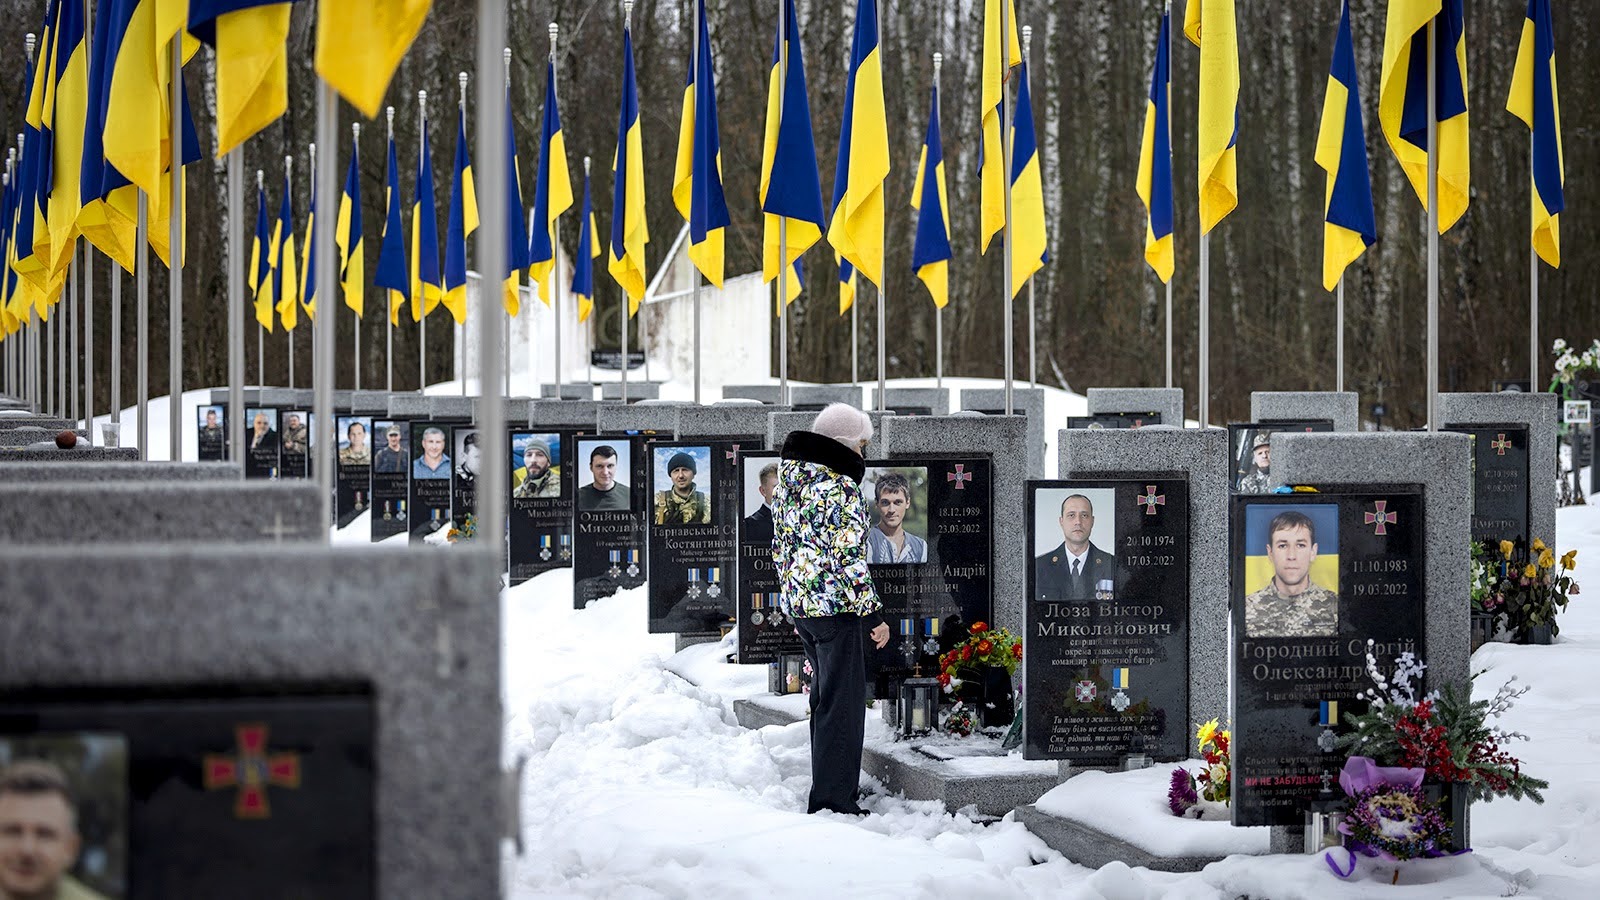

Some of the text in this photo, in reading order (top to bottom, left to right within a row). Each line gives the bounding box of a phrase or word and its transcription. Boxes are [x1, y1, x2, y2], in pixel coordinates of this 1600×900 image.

[718, 479, 737, 487] 19.10
[551, 498, 572, 508] Рост
[527, 508, 573, 518] Михайлов
[580, 511, 637, 522] Олійник
[939, 507, 981, 517] 18.12.1989
[579, 522, 646, 533] Миколайо
[652, 524, 736, 539] Тарнавський Се
[938, 523, 981, 533] 23.03.2022
[665, 538, 736, 550] Костянтинов
[1126, 535, 1175, 547] 20.10.1974
[742, 544, 773, 557] Піпк
[1127, 555, 1175, 566] 17.03.2022
[1353, 559, 1408, 572] 11.10.1983
[872, 563, 986, 580] асковський Андрій
[1353, 583, 1408, 596] 19.03.2022
[1045, 601, 1164, 620] Лоза Віктор
[1037, 621, 1172, 637] Миколайович
[1242, 640, 1340, 663] Городний
[1244, 777, 1258, 787] МИ
[1260, 776, 1272, 786] НЕ
[1274, 775, 1320, 786] ЗАБУДЕМО
